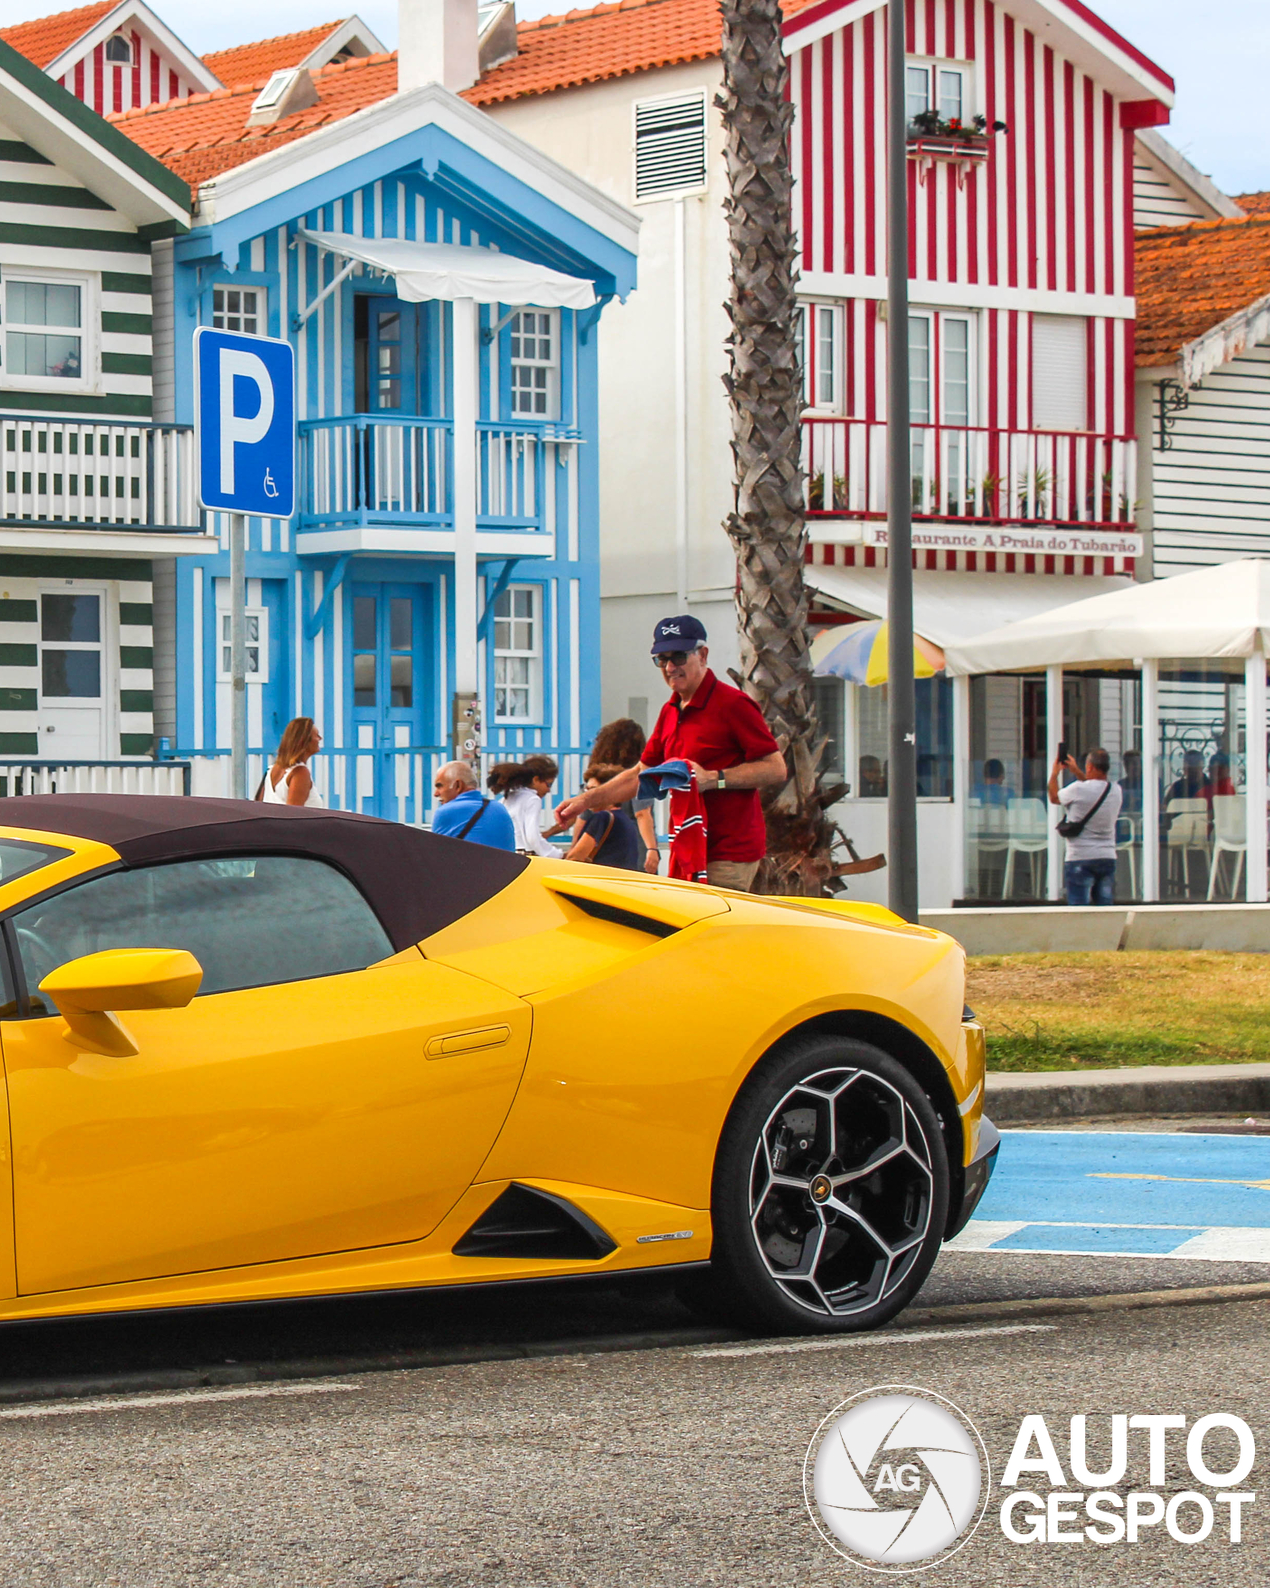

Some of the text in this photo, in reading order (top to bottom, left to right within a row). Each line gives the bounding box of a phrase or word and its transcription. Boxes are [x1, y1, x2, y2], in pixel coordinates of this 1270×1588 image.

[220, 347, 274, 495] P
[875, 530, 1136, 553] Raurante A Praia do Tubarão
